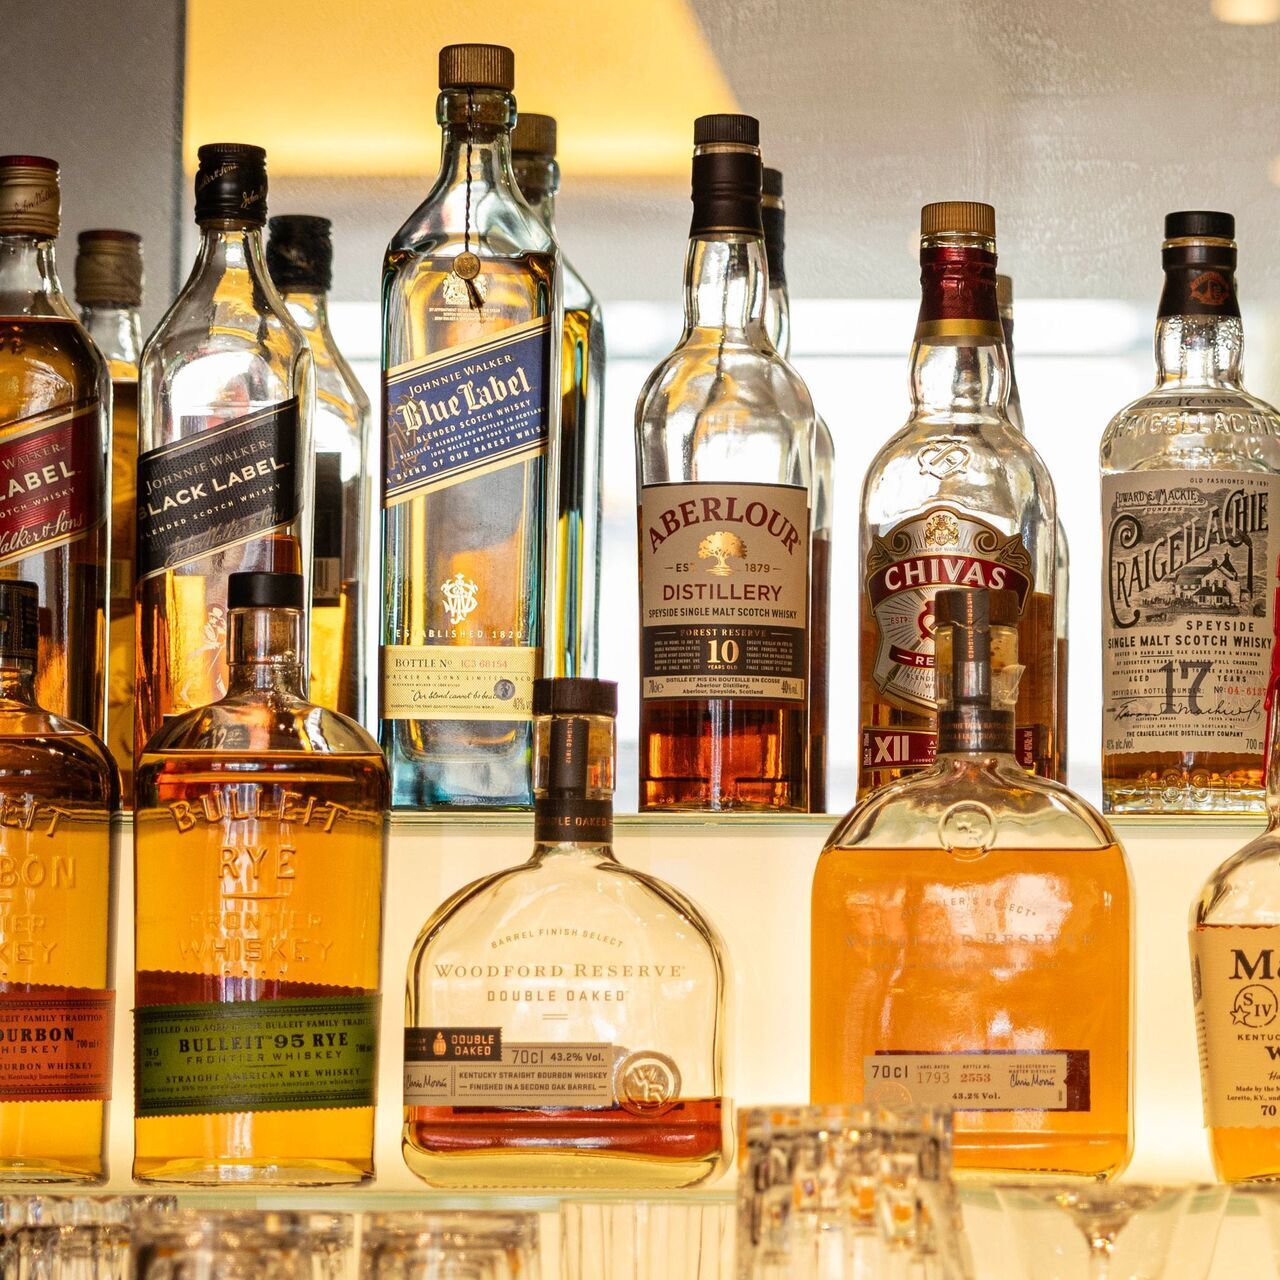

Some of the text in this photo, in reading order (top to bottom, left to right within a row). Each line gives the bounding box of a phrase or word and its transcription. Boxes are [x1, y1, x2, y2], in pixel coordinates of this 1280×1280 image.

[408, 354, 512, 397] JOHNNIE WALKER
[396, 367, 531, 435] Blue Label
[417, 400, 531, 443] BLENDED SCOTCH WHISKY
[2, 444, 62, 471] WALKER
[146, 441, 267, 494] JOHNNIE WALKER
[212, 457, 285, 492] LABEL
[648, 496, 800, 555] ABERLOUR
[884, 557, 1006, 591] CHIVAS
[663, 584, 782, 602] DISTILLERY
[649, 608, 797, 619] SPEYSIDE SINGLE MALT SCOTCH WHISKY
[1187, 621, 1254, 632] SPEYSIDE
[708, 639, 739, 664] 10
[1108, 635, 1272, 649] SINGLE MALT SCOTCH WHISKY
[1160, 661, 1214, 716] 17
[874, 736, 909, 762] XII
[169, 790, 350, 834] BULLEIT
[218, 847, 297, 880] RYE
[490, 928, 624, 948] BARREL FINISH SELECT
[435, 963, 682, 978] WOODFORD RESERVE
[488, 990, 625, 1001] DOUBLE OAKED
[179, 1033, 348, 1053] BULLEIT 95 RYE
[451, 1035, 494, 1045] DOUBLE
[454, 1045, 491, 1055] OAKED
[187, 1051, 343, 1064] FRONTIER WHISKEY
[512, 1049, 604, 1064] 70cl 43.2% Vol.
[460, 1071, 607, 1079] KENTUCKY STRAIGHT BOURBON WHISKEY
[1261, 1105, 1276, 1116] 70
